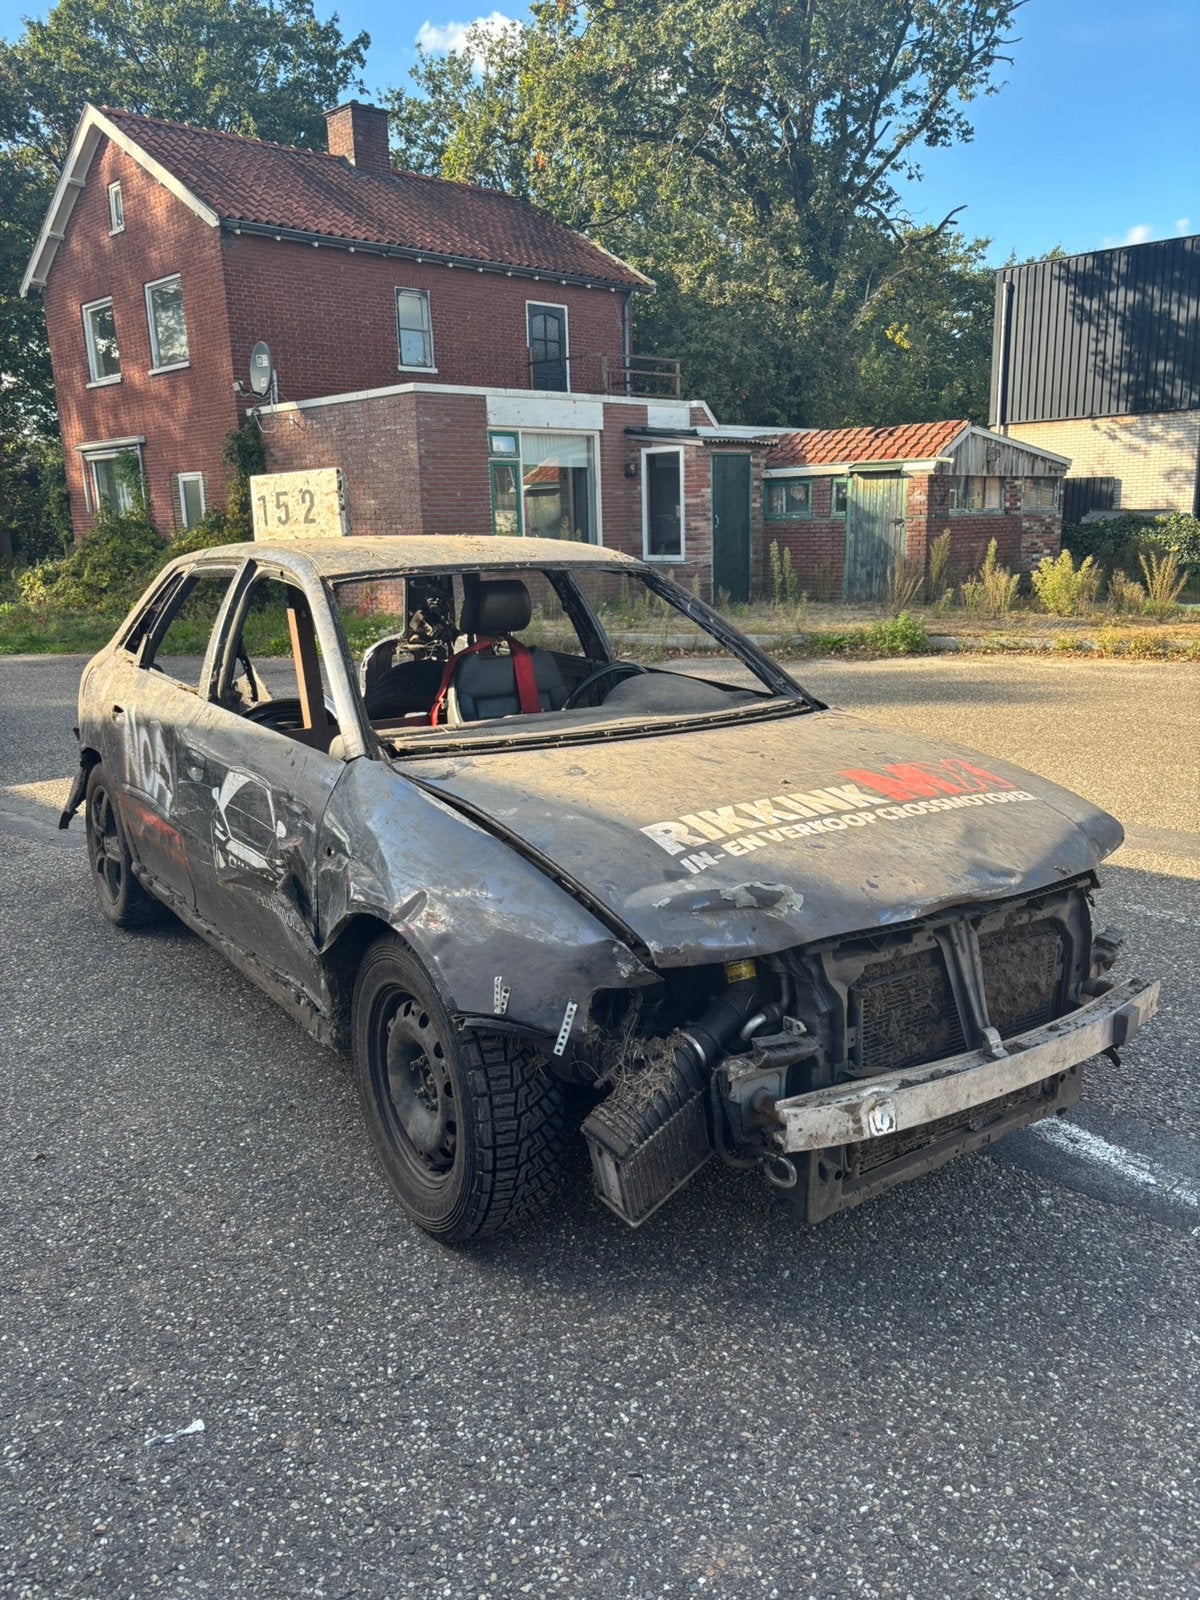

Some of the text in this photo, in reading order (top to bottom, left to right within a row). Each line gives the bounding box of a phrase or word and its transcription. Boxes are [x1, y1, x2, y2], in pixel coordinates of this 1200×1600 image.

[257, 489, 317, 526] 152
[639, 783, 890, 856] RIKKINK
[720, 834, 767, 857] EN
[759, 810, 877, 843] VERKOOP
